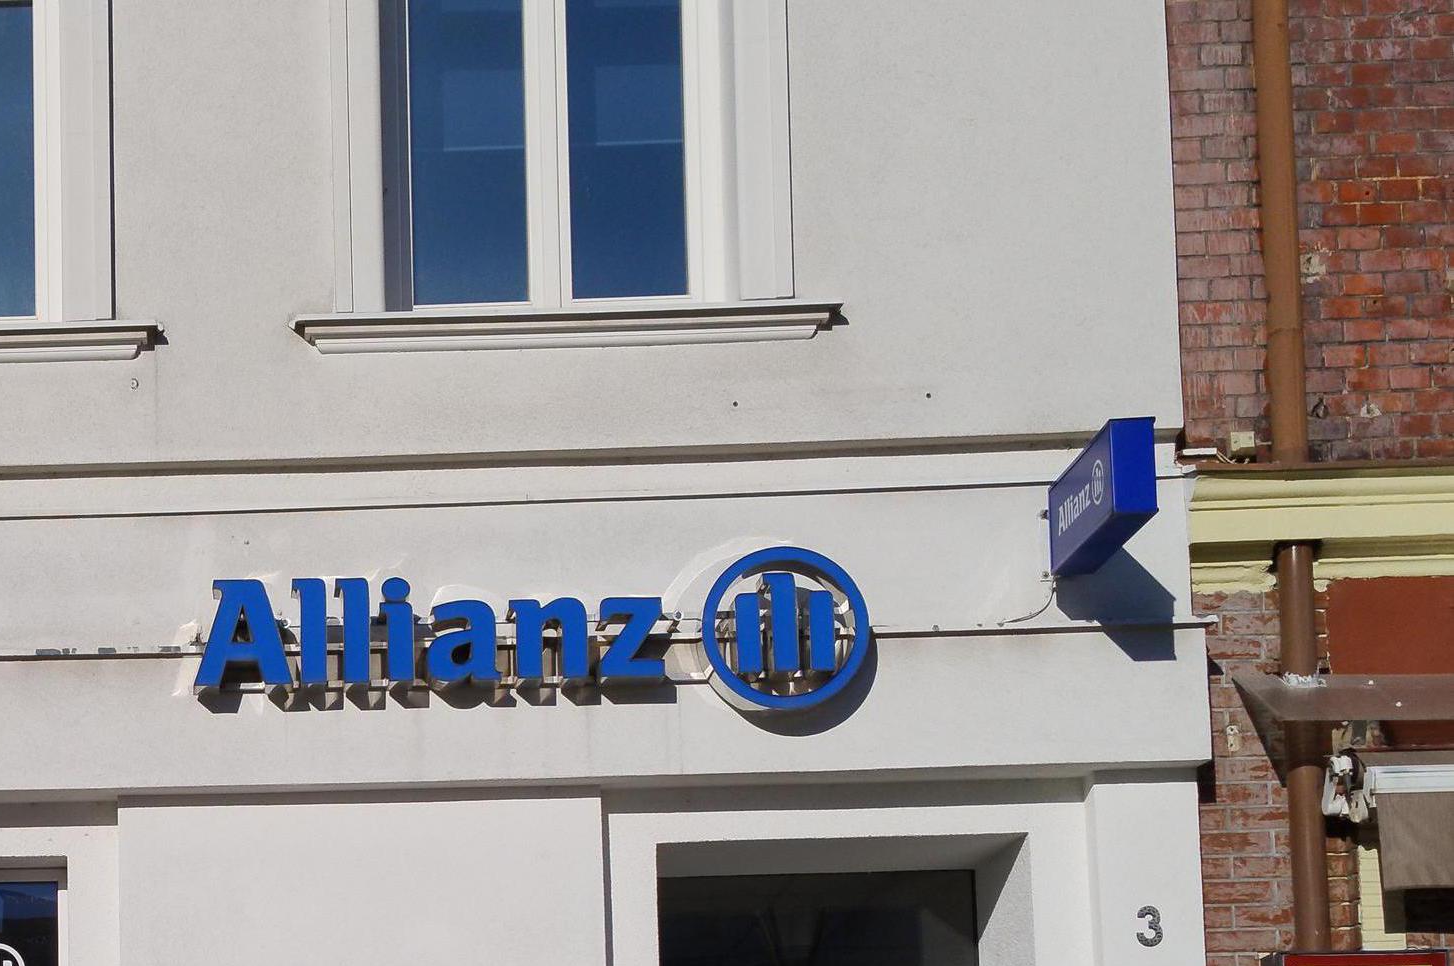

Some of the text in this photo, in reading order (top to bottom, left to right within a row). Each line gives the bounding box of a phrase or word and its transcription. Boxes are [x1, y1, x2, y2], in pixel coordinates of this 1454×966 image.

[1058, 481, 1091, 537] Allianz
[195, 576, 666, 687] Allianz
[1137, 905, 1164, 947] 3
